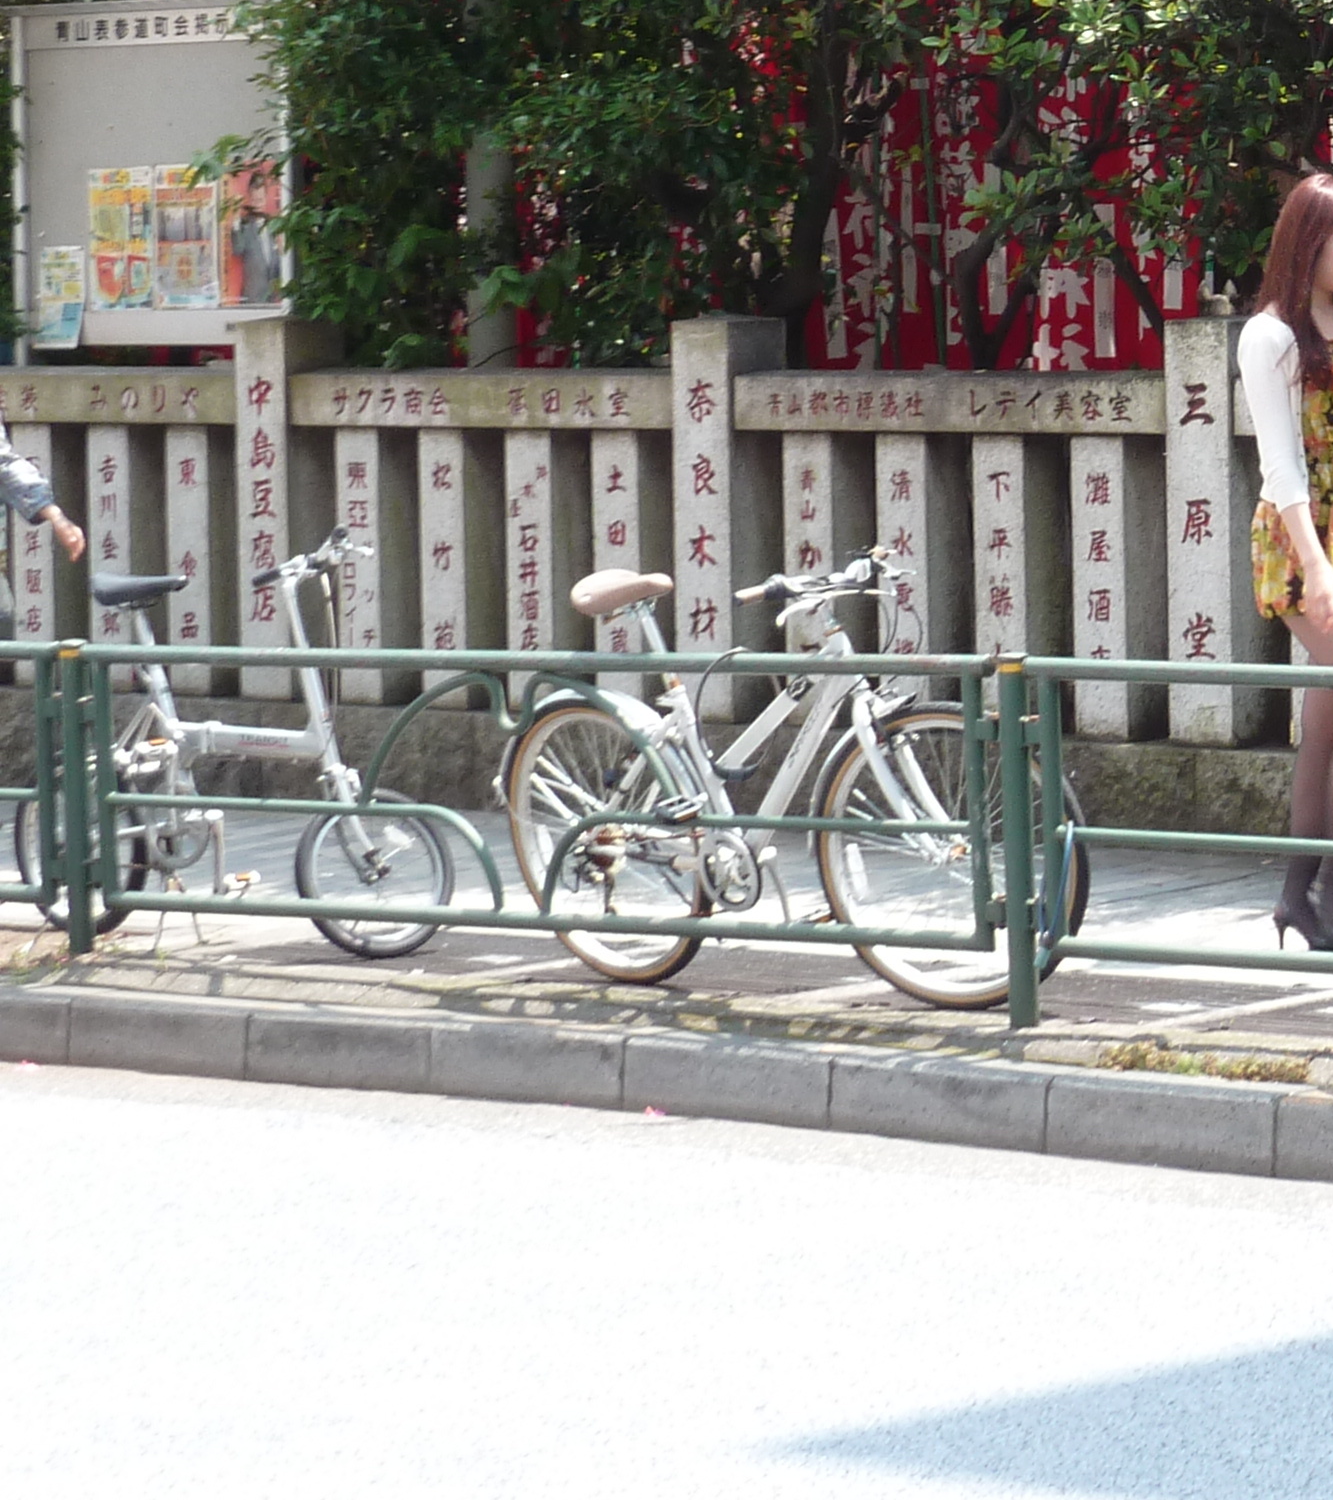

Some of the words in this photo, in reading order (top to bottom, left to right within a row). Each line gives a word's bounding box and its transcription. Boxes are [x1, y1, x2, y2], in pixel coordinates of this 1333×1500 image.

[332, 387, 450, 416] サクラ商会
[97, 454, 121, 637] 吉川金郎
[248, 376, 278, 623] 中島豆腐店
[516, 523, 541, 651] 石井酒店
[606, 464, 629, 653] 土田蔵
[685, 378, 719, 642] 奈良木材
[1179, 381, 1217, 661] 三原堂
